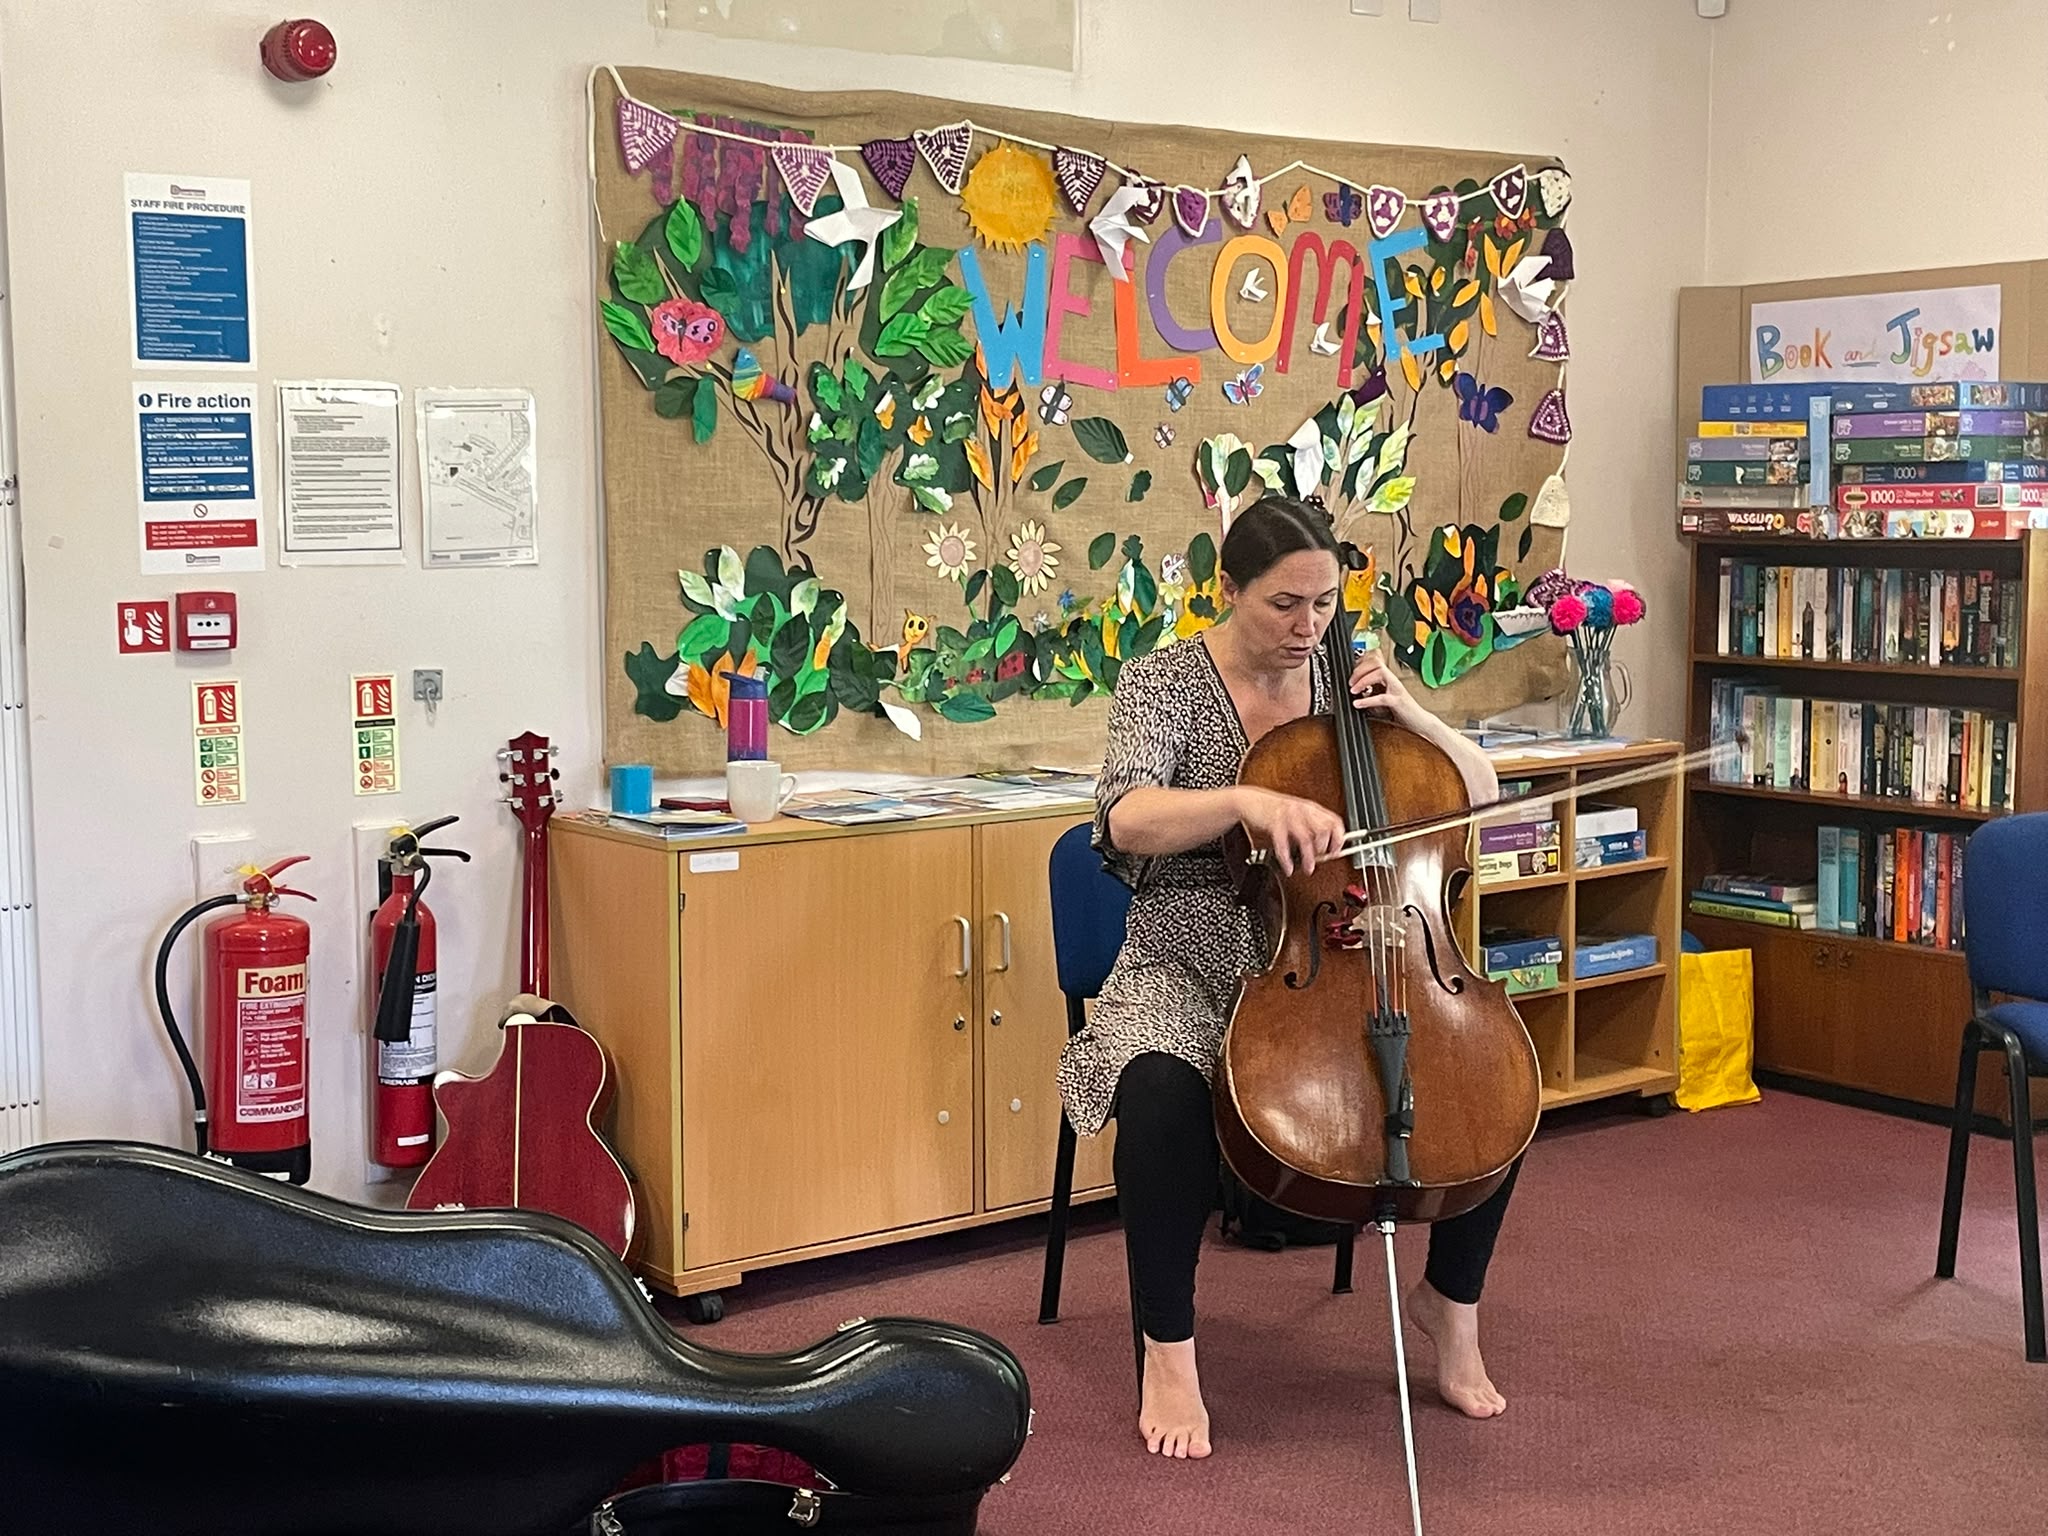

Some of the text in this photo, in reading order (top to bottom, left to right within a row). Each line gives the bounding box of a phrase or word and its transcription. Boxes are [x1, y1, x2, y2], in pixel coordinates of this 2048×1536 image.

[131, 199, 246, 214] STAFF FIRE PROCEDURE
[958, 218, 1445, 390] WELCOME
[1886, 307, 1994, 377] Jigsaw
[158, 393, 251, 408] Fire action
[1894, 466, 1916, 479] 1000
[1871, 490, 1895, 504] 1000
[2021, 488, 2039, 503] 1000
[245, 972, 303, 994] Foam
[239, 1102, 303, 1117] COMMANDER
